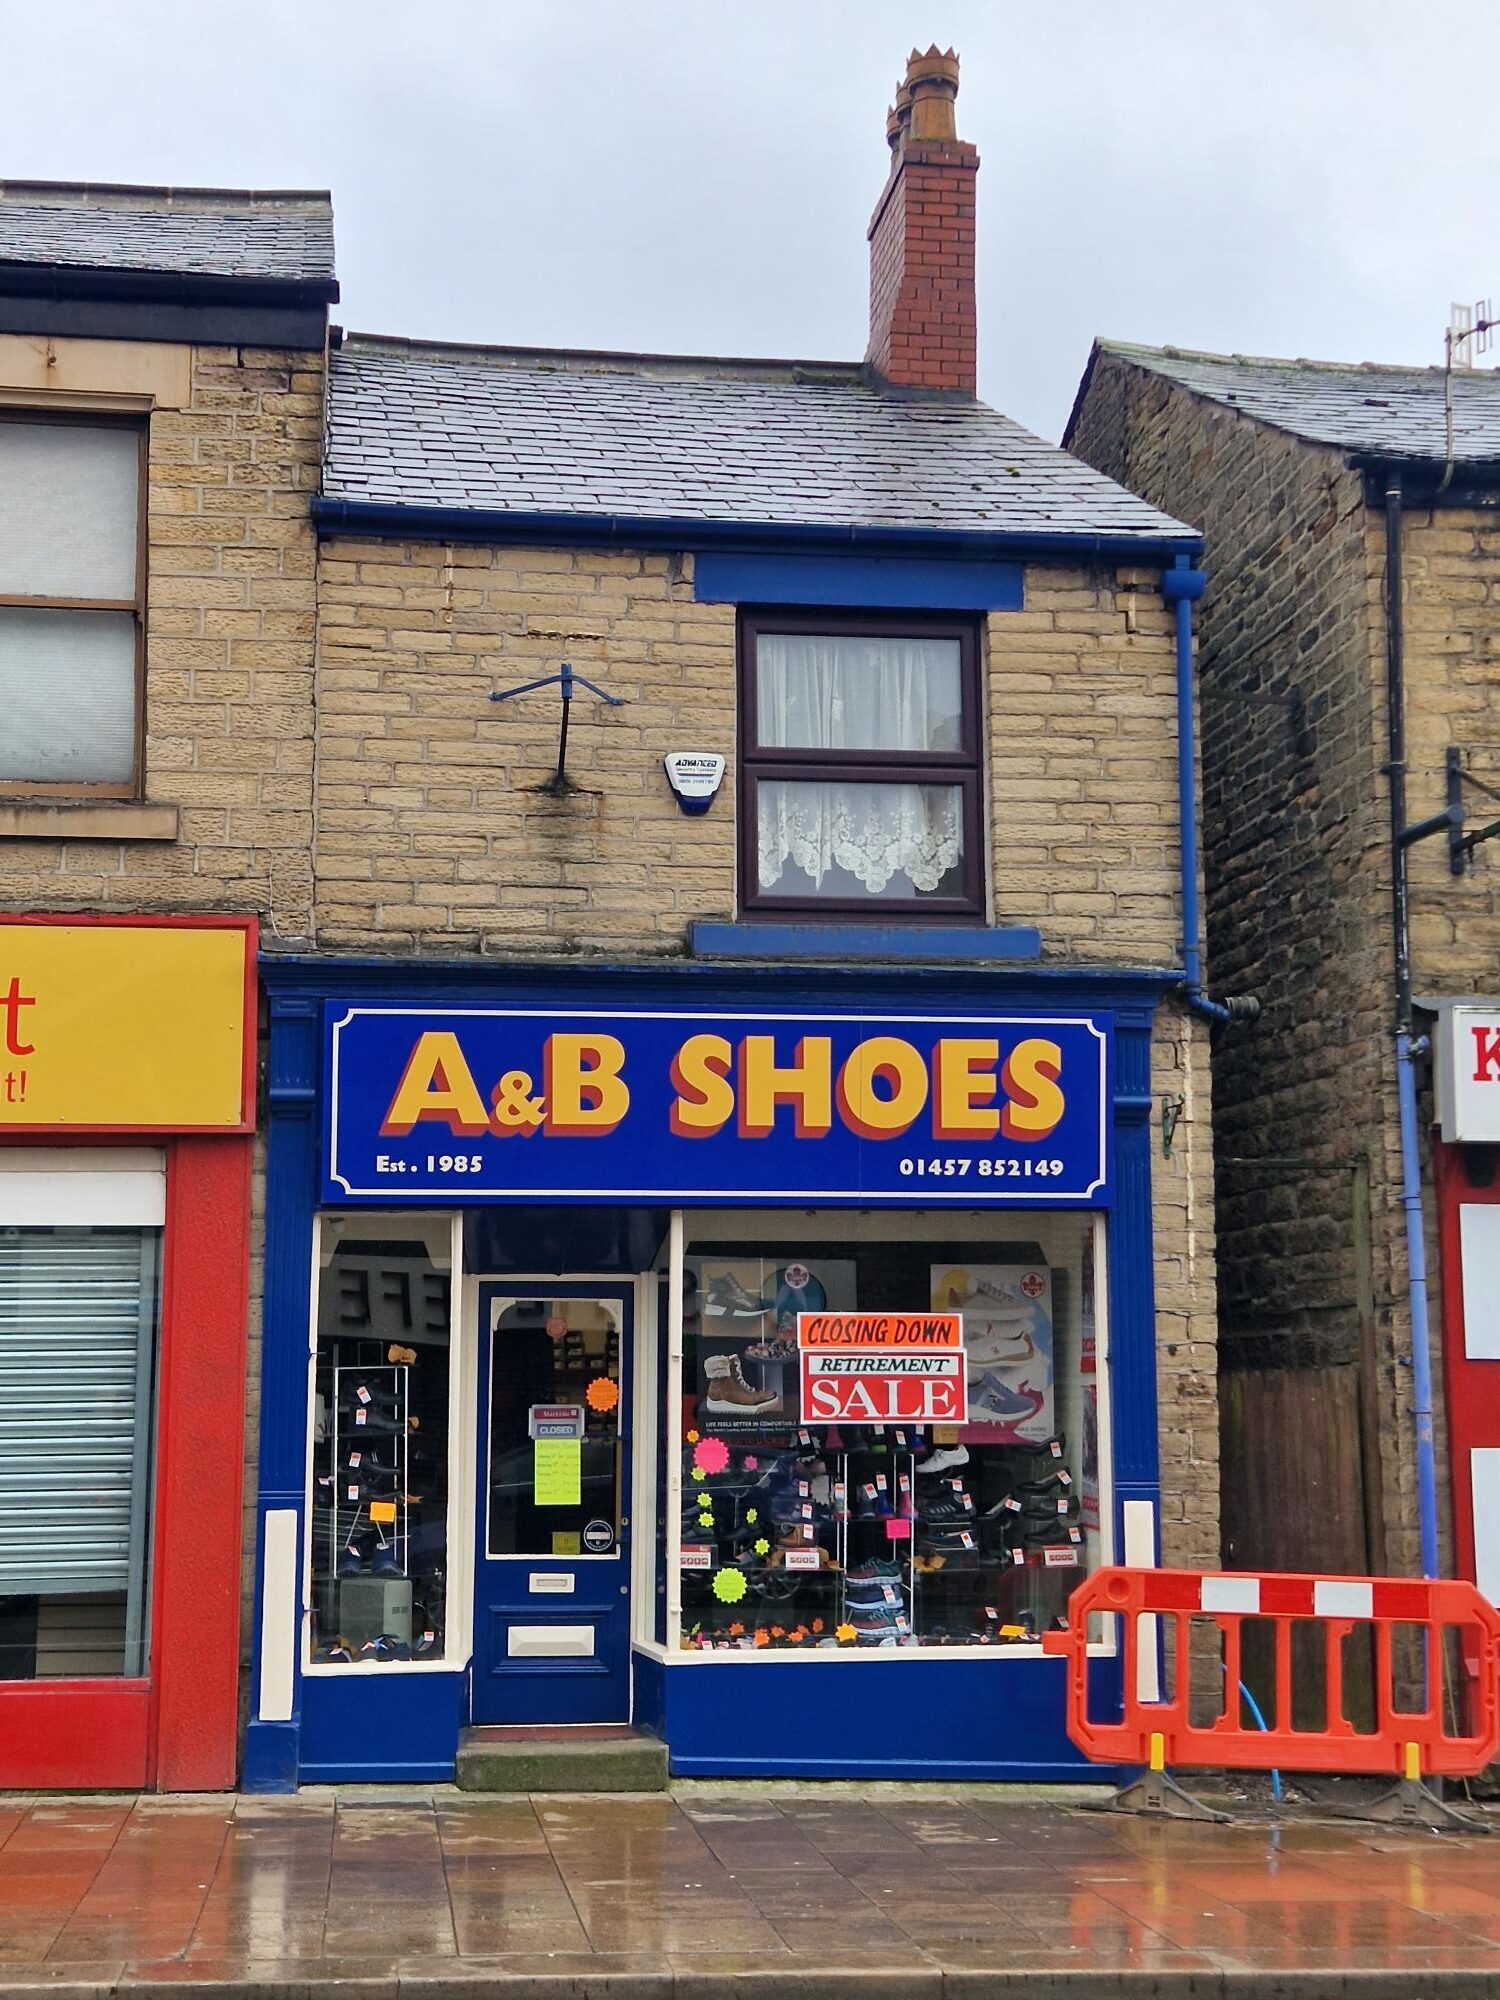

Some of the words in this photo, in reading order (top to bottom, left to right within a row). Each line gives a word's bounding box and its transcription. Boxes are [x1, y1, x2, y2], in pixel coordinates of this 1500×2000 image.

[675, 759, 718, 768] ADVANCED
[4, 1071, 27, 1103] t!
[379, 1031, 630, 1138] A&B
[669, 1034, 1065, 1142] SHOES
[426, 1155, 483, 1173] 1985
[899, 1159, 971, 1176] 01457
[978, 1159, 1064, 1177] 852149
[807, 1317, 889, 1345] CLOSING
[894, 1318, 953, 1345] DOWN
[819, 1357, 950, 1373] RETIREMENT
[811, 1379, 958, 1418] SALE
[539, 1426, 574, 1435] CLOSED
